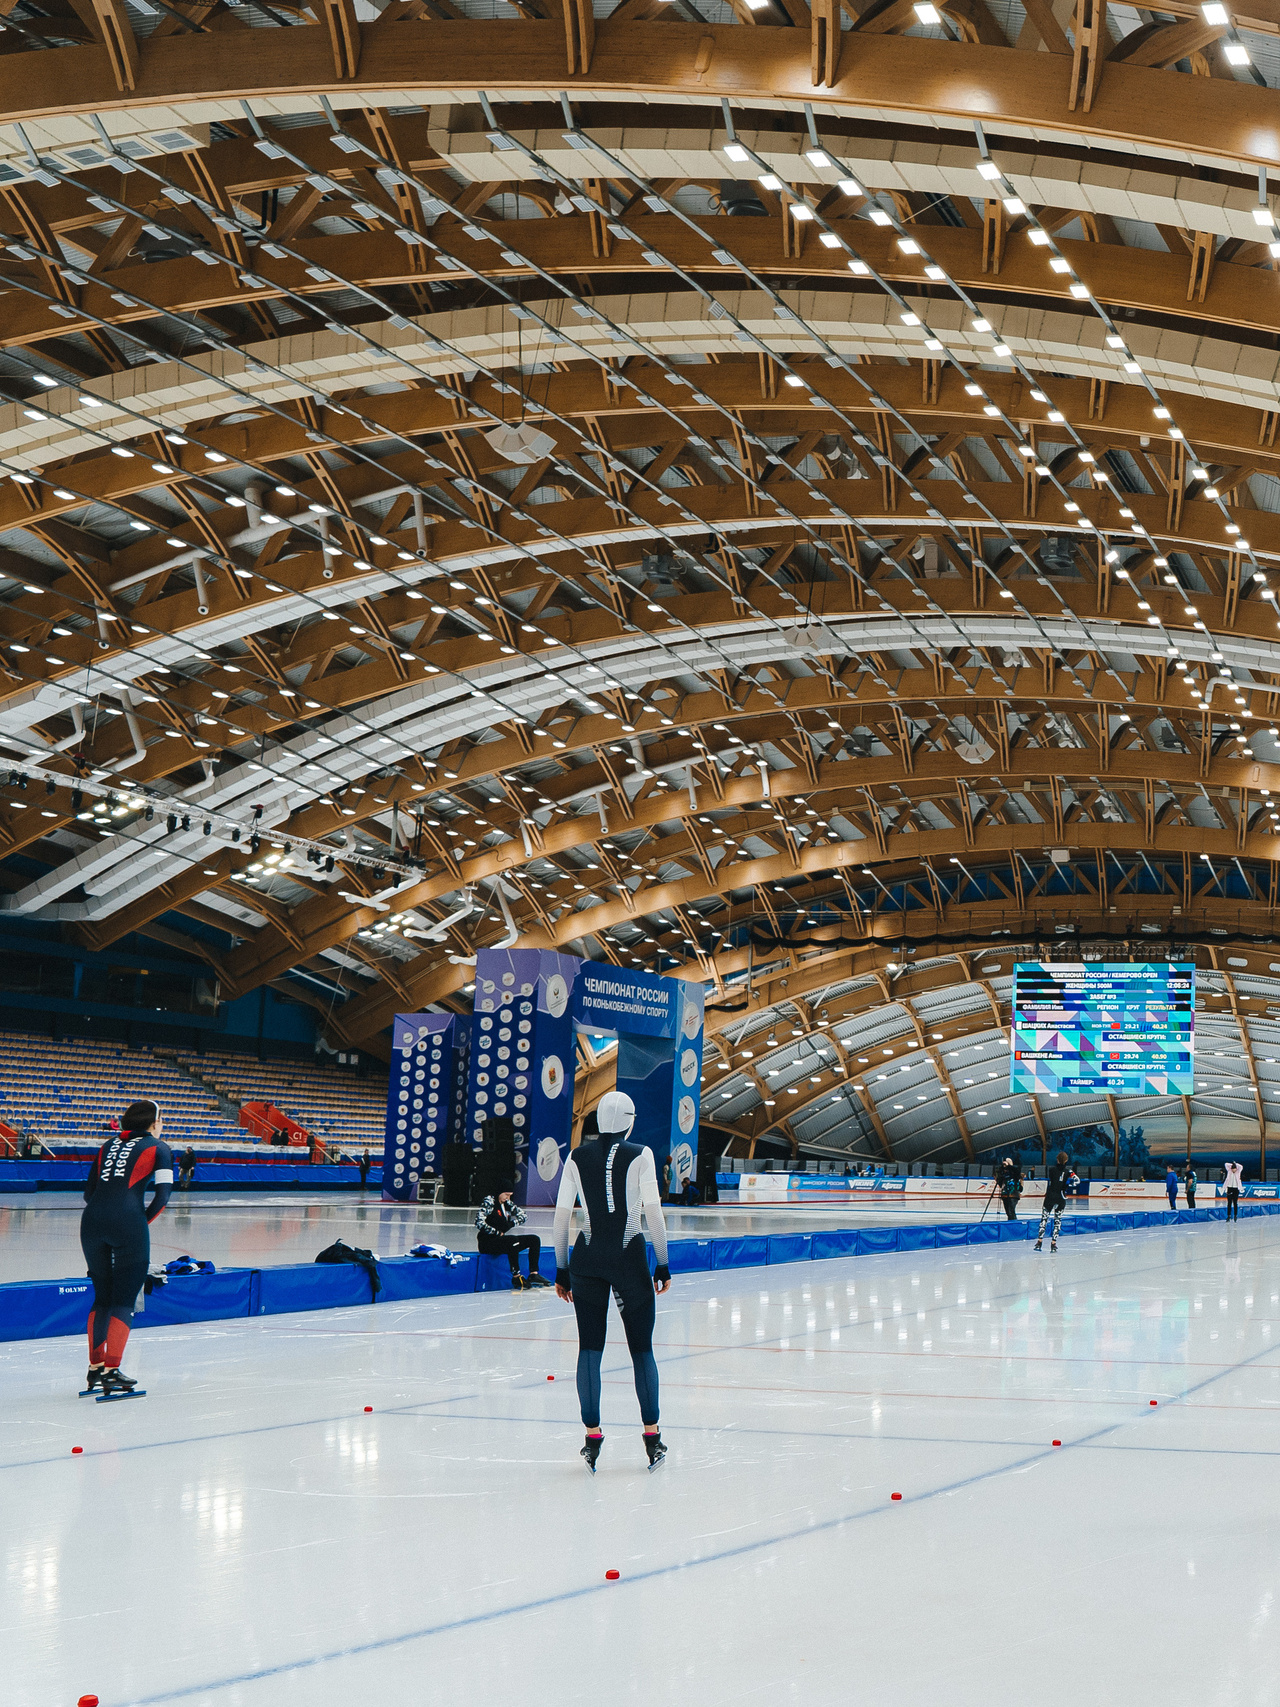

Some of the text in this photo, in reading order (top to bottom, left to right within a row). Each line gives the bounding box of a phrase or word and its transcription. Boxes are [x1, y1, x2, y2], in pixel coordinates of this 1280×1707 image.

[584, 977, 669, 1004] ЧЕМПИОНАТ РОССИИ
[582, 996, 669, 1018] ПО КОНЬКОБЕЖНОМУ СПОРТУ
[100, 1137, 123, 1182] MOSCO
